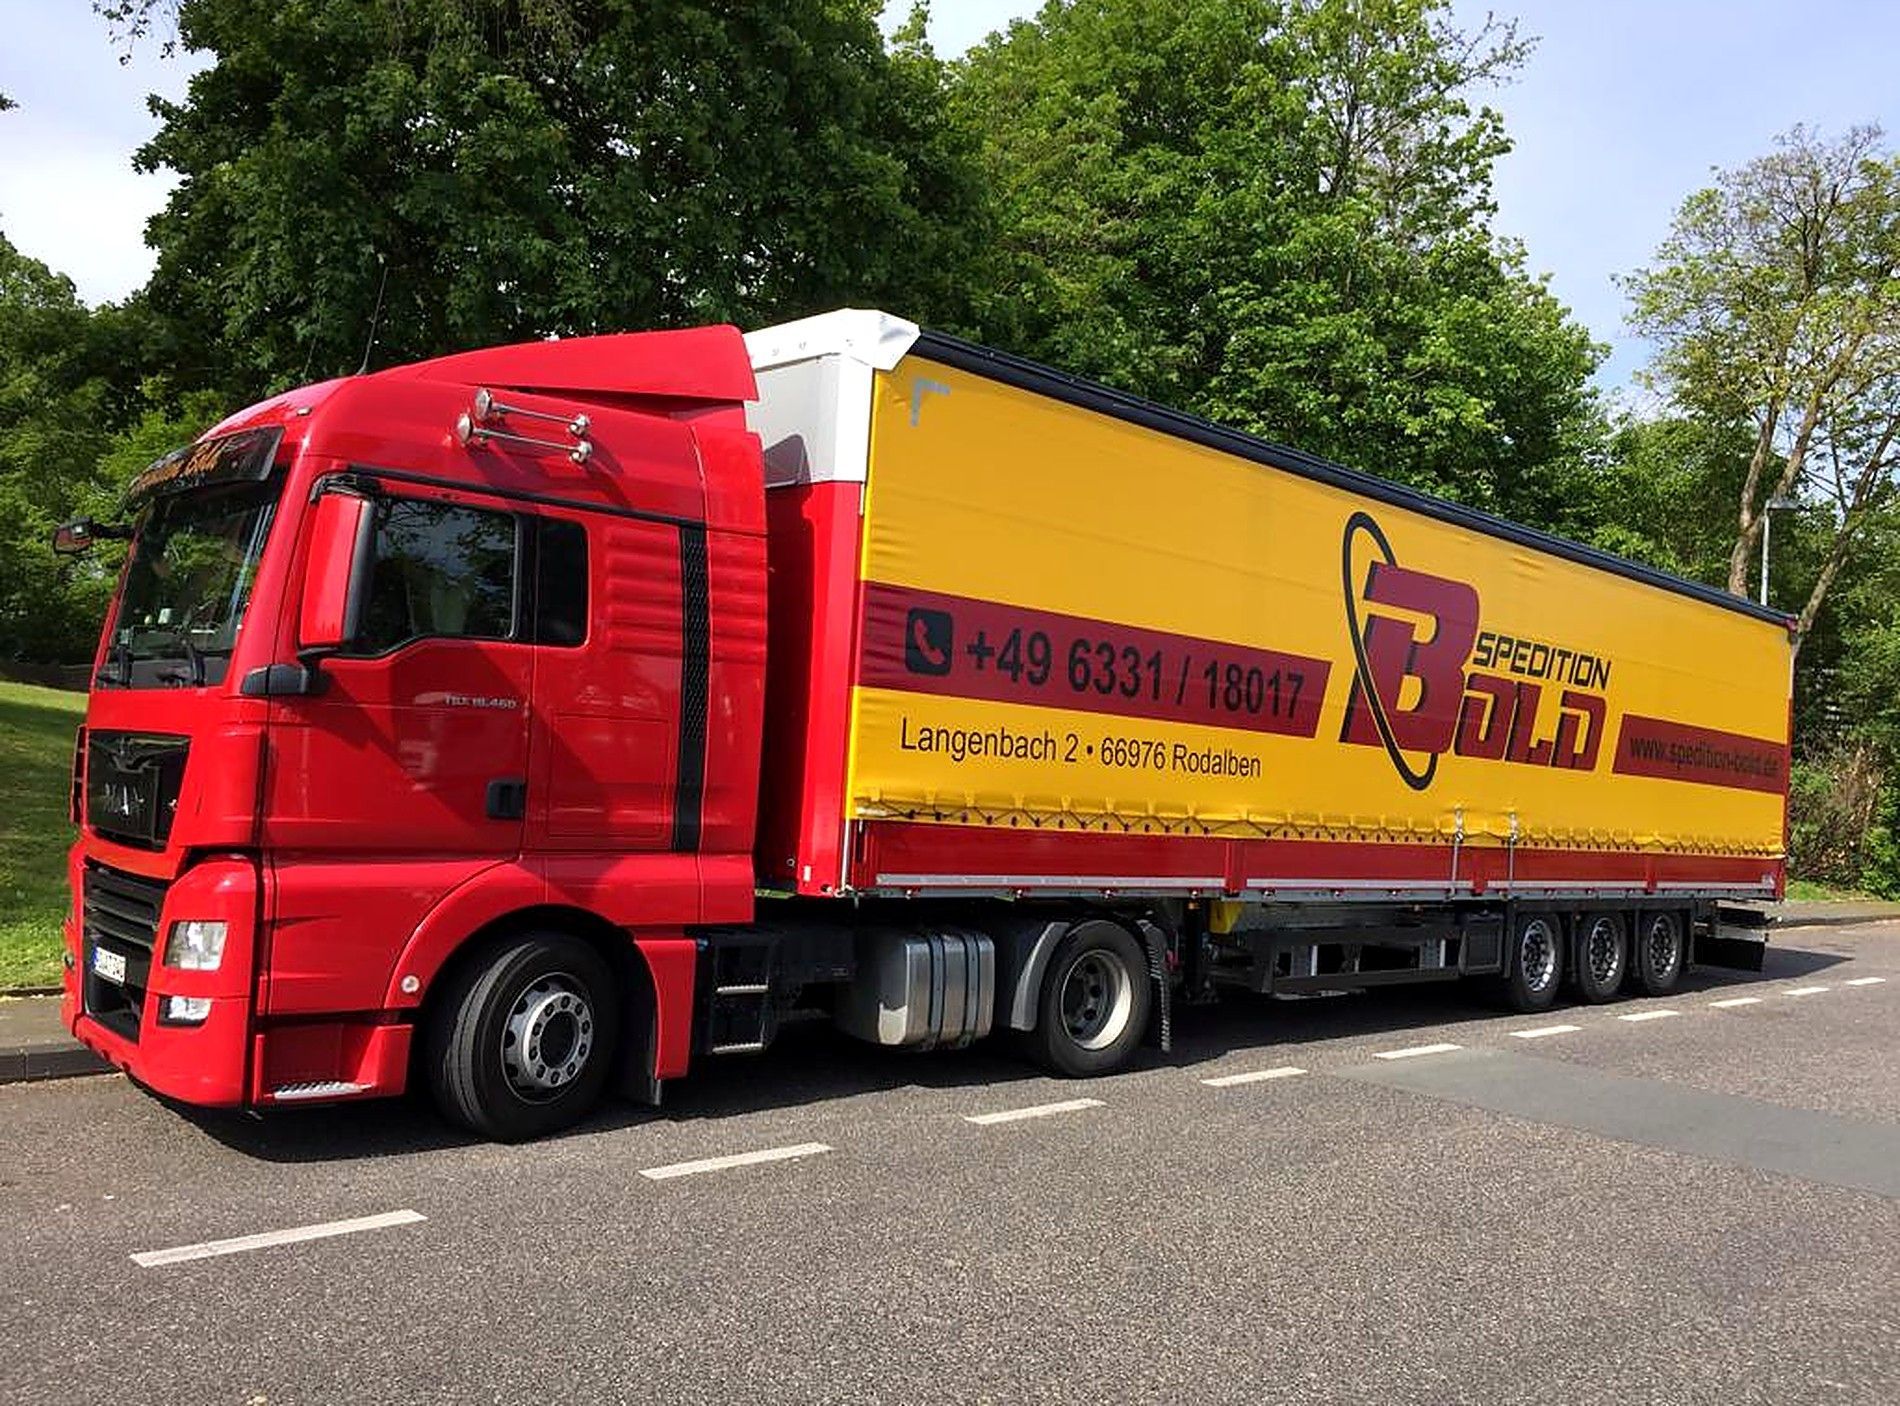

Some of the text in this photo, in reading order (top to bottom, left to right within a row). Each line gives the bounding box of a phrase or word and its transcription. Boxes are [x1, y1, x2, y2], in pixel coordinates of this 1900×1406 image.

[966, 628, 1306, 719] +49 6331 / 18017
[1471, 631, 1613, 690] SPEDITION
[901, 717, 1262, 778] Langenbach 2 66976 Rodalben
